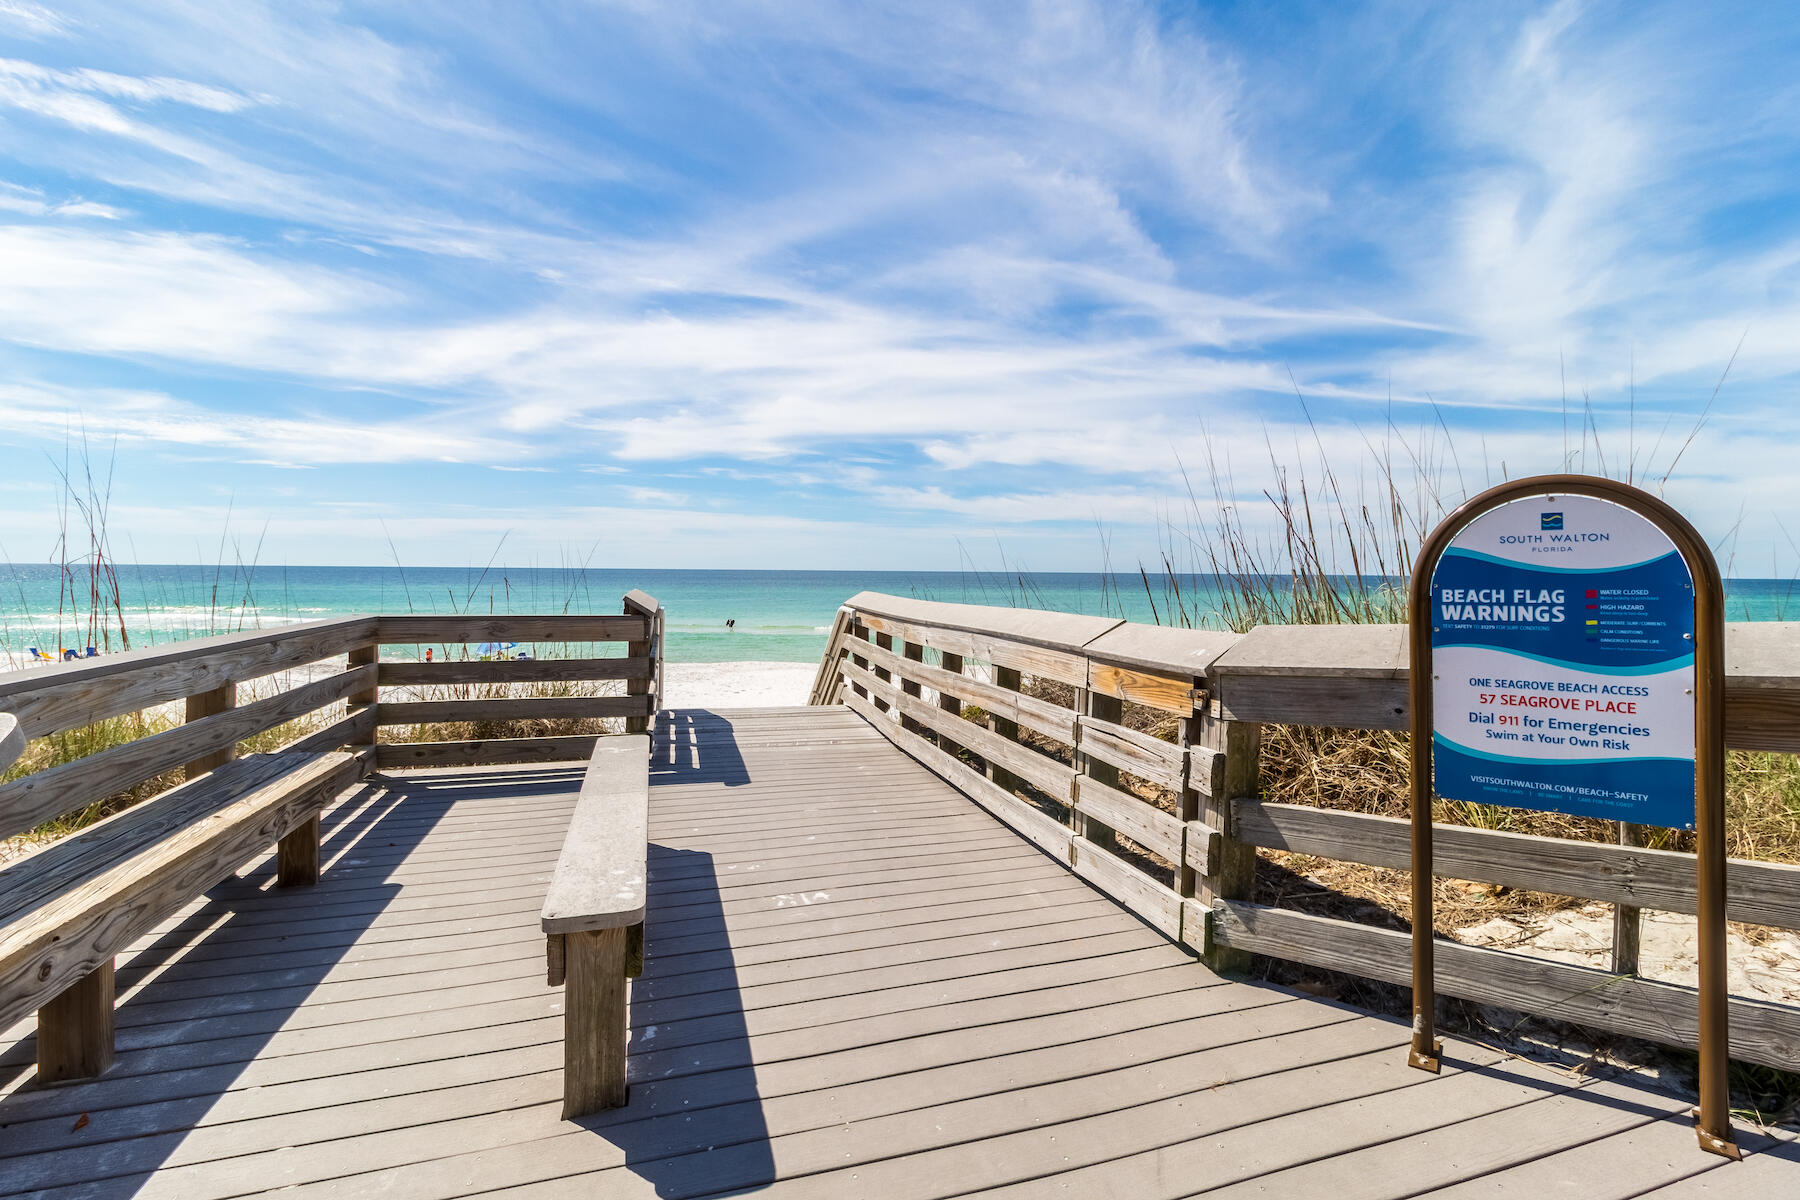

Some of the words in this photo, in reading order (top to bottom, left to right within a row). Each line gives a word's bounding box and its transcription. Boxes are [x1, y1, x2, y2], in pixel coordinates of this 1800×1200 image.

[1499, 534, 1543, 544] SOUTH
[1549, 533, 1610, 543] WALTON
[1441, 589, 1505, 603] BEACH
[1513, 589, 1565, 604] FLAG
[1441, 604, 1565, 622] WARNINGS
[1469, 677, 1492, 688] ONE
[1494, 679, 1555, 691] SEAGROVE
[1557, 682, 1598, 693] BEACH
[1601, 685, 1649, 696] ACCESS
[1479, 694, 1496, 704] 57
[1500, 694, 1580, 711] SEAGROVE
[1585, 699, 1637, 714] PLACE
[1469, 712, 1494, 724] Dial
[1498, 715, 1519, 726] 911
[1523, 716, 1544, 728] for
[1548, 718, 1650, 737] Emergencies
[1485, 729, 1519, 741] Swim
[1522, 734, 1534, 742] at
[1537, 733, 1566, 745] Your
[1569, 736, 1599, 748] Own
[1602, 739, 1630, 750] Risk
[1470, 775, 1649, 802] VISITSOUTHWALTON.COM/BEACH-SAFETY
